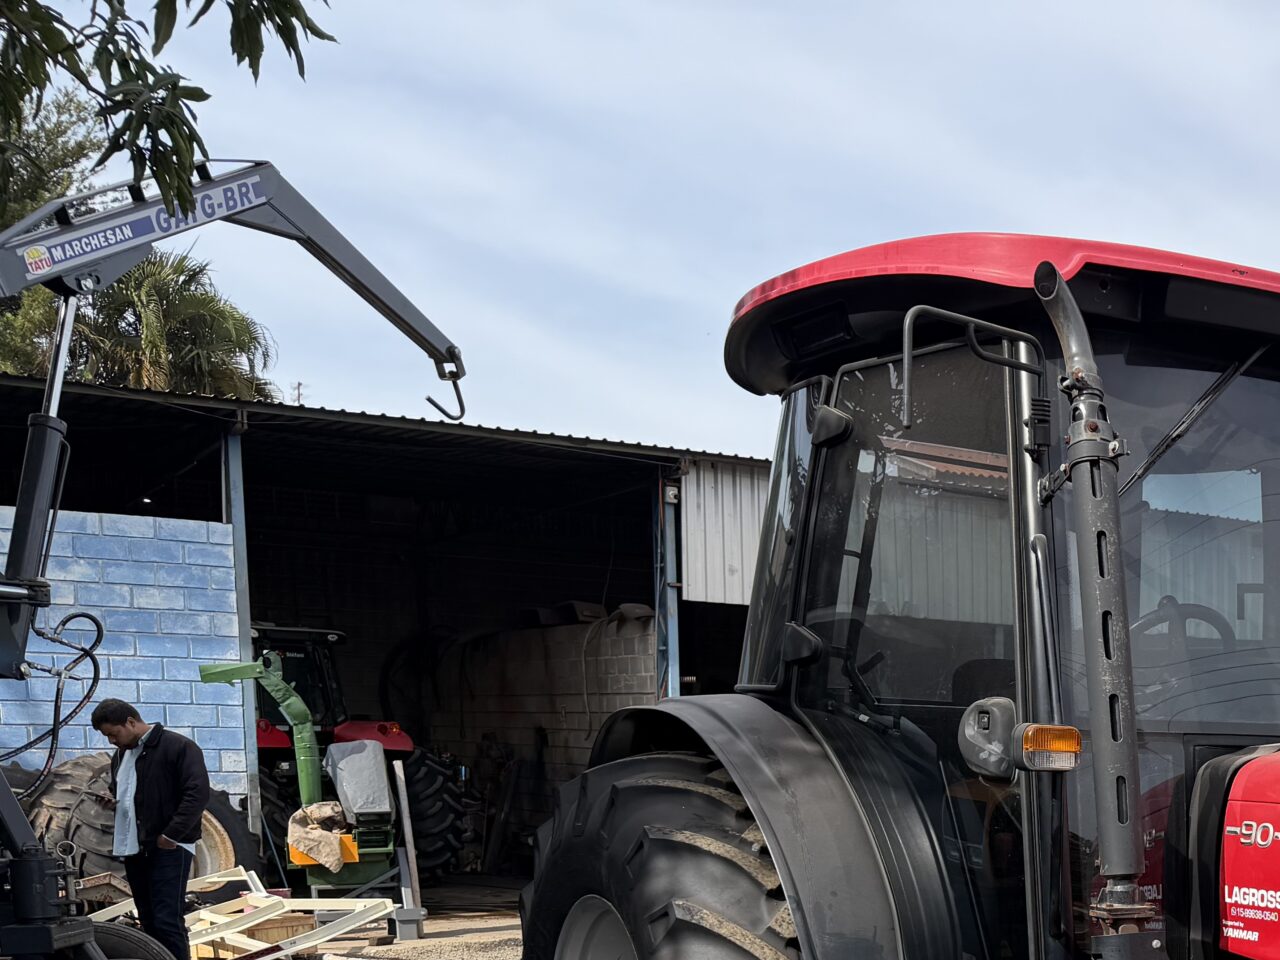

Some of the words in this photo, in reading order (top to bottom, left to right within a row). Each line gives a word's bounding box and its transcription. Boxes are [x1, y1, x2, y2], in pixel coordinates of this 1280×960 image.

[27, 256, 52, 273] TATU
[50, 224, 133, 262] MARCHESAN
[1222, 926, 1259, 942] YANMAR
